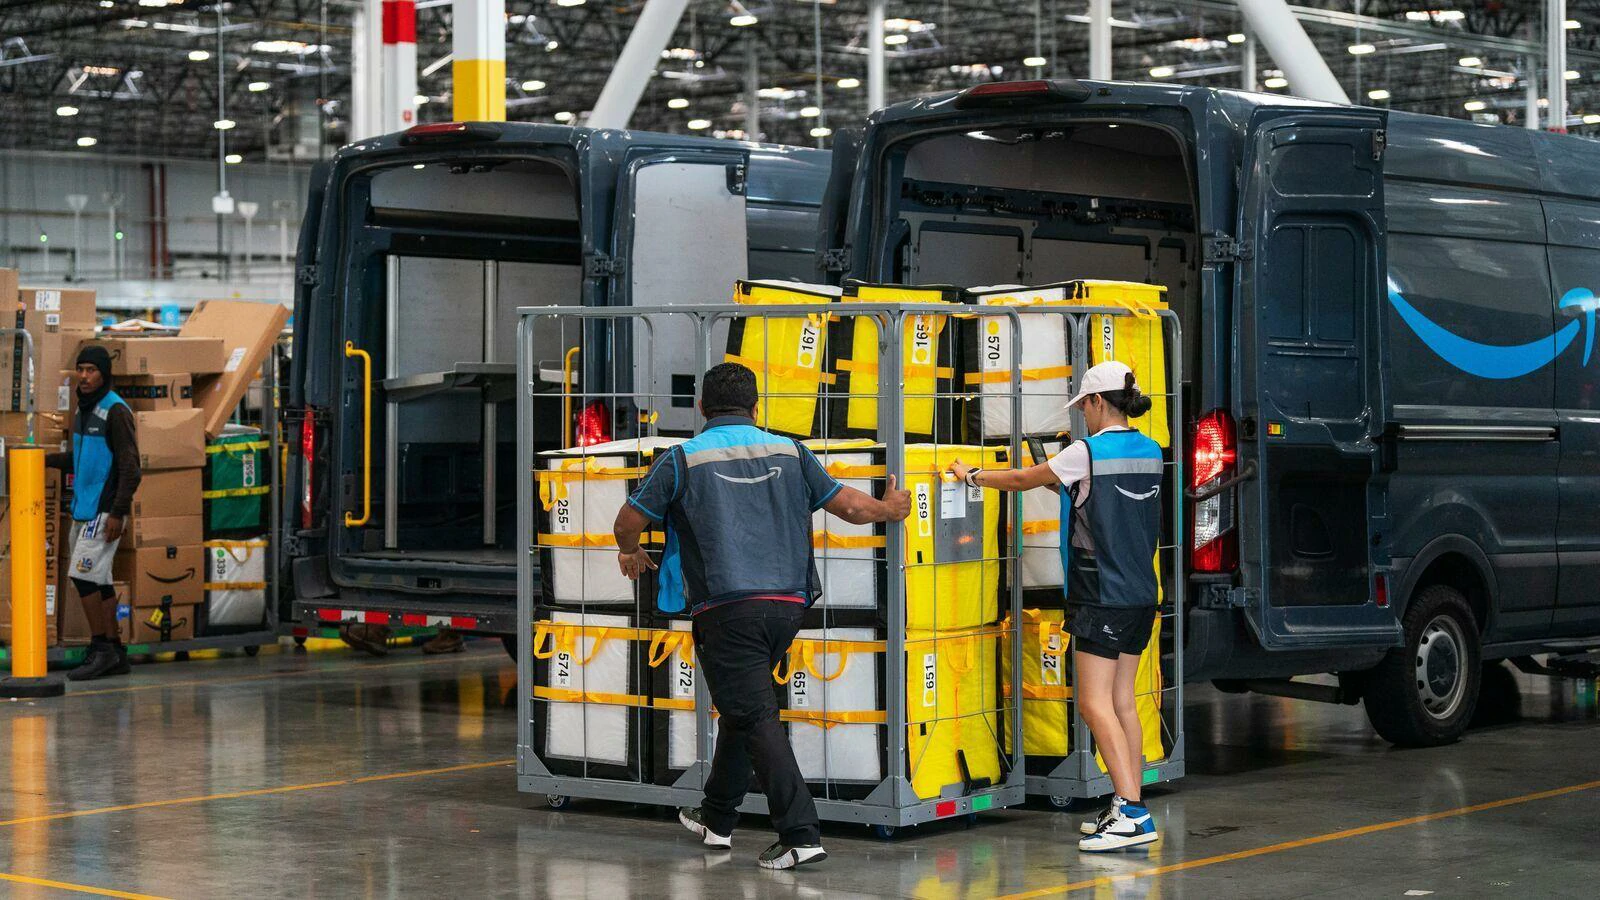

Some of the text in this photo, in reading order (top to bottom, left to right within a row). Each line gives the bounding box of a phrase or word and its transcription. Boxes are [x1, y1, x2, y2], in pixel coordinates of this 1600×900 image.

[802, 327, 815, 351] 167
[916, 324, 929, 347] 165
[988, 335, 1000, 360] 570
[558, 499, 569, 524] 255
[918, 493, 928, 519] 653
[45, 479, 56, 580] TREADMILL
[217, 558, 226, 575] 339
[558, 652, 569, 677] 574
[680, 661, 692, 687] 572
[925, 665, 934, 689] 651
[793, 671, 806, 696] 651
